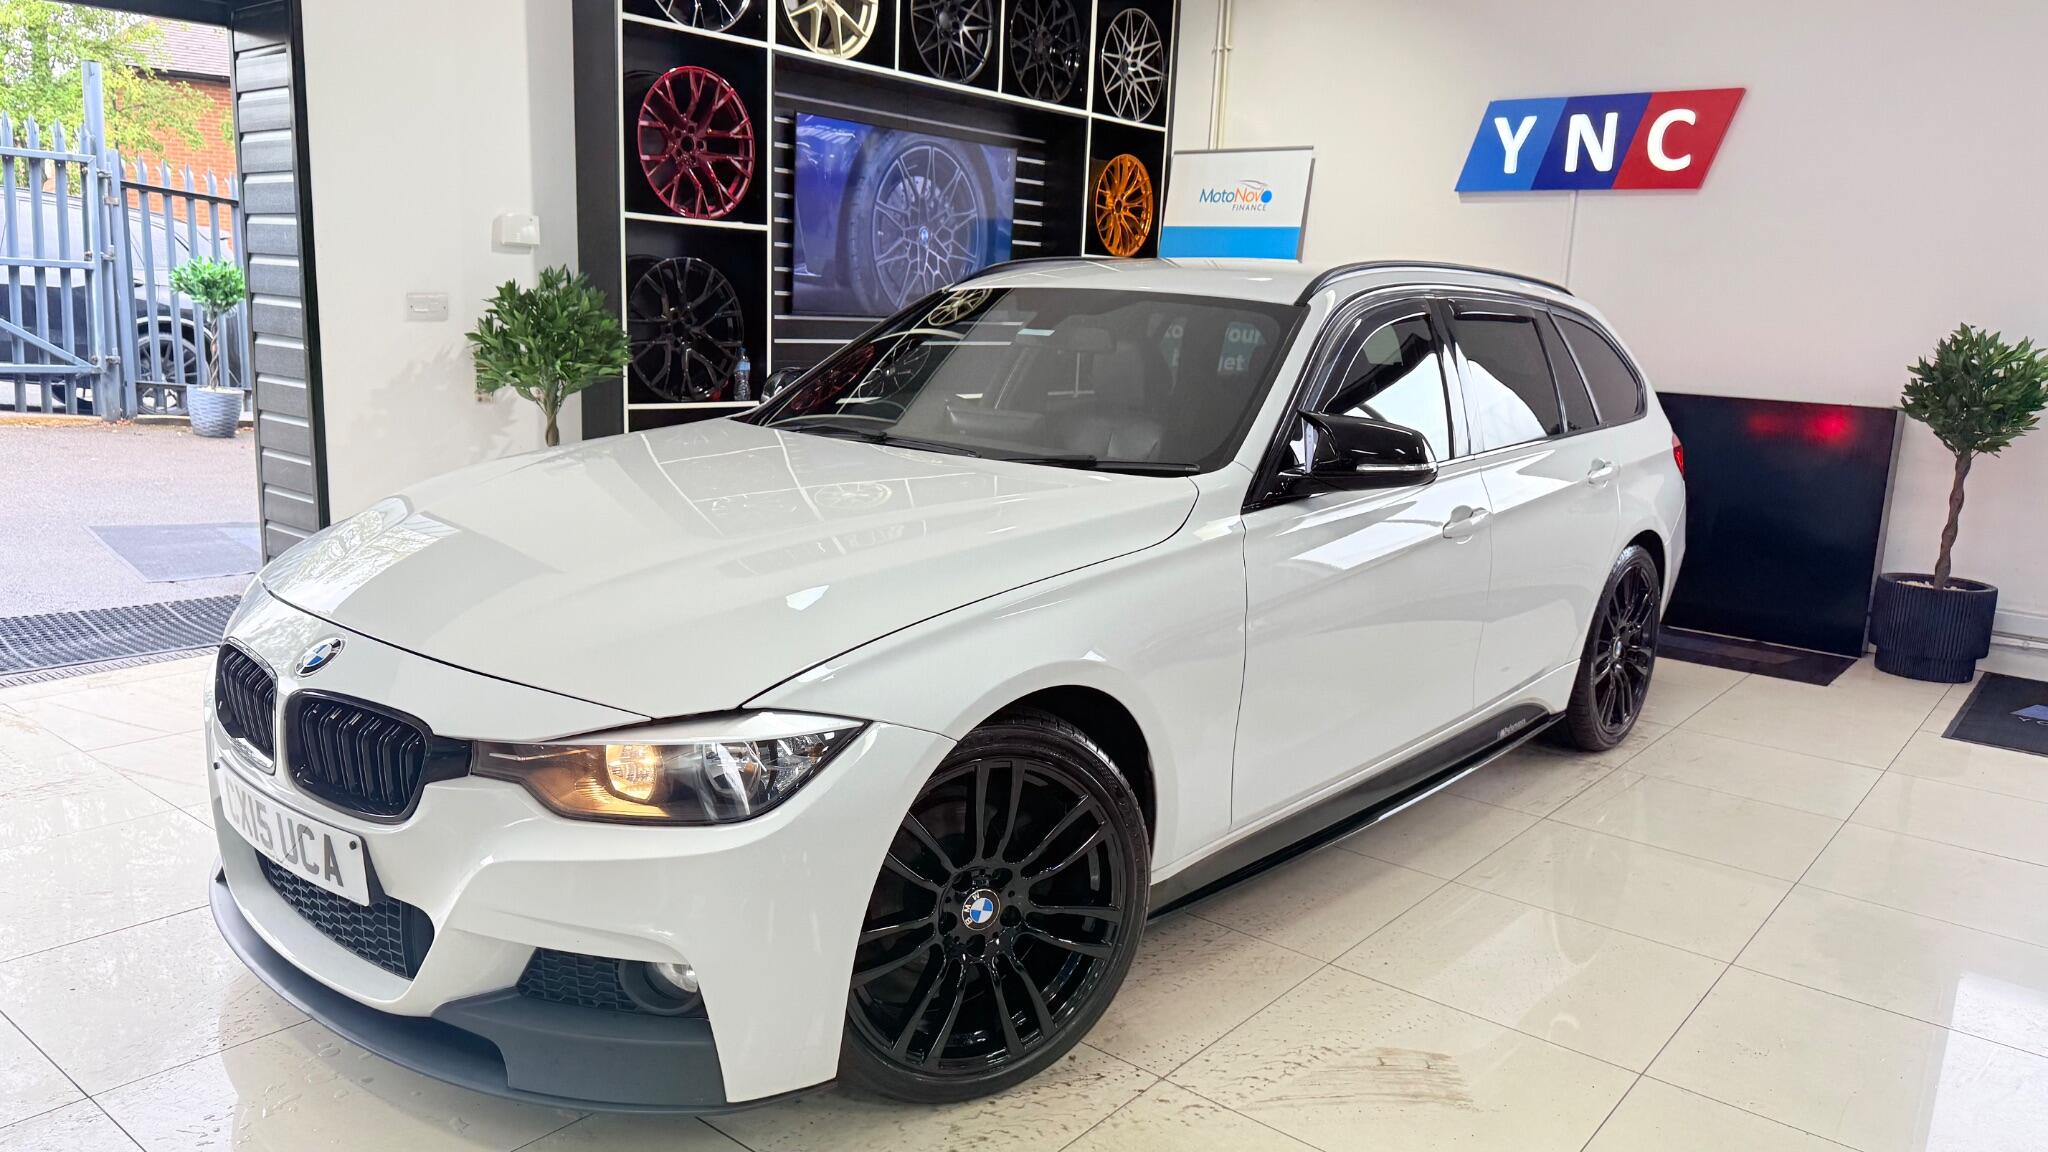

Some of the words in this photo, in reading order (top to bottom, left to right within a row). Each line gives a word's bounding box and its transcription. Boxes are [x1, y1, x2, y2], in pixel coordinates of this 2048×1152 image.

[1494, 108, 1696, 174] YNC
[1199, 187, 1272, 203] MotoNovo
[1232, 204, 1267, 212] FINANCE
[225, 776, 274, 850] CX15
[276, 811, 345, 888] UCA
[963, 890, 981, 926] BMW
